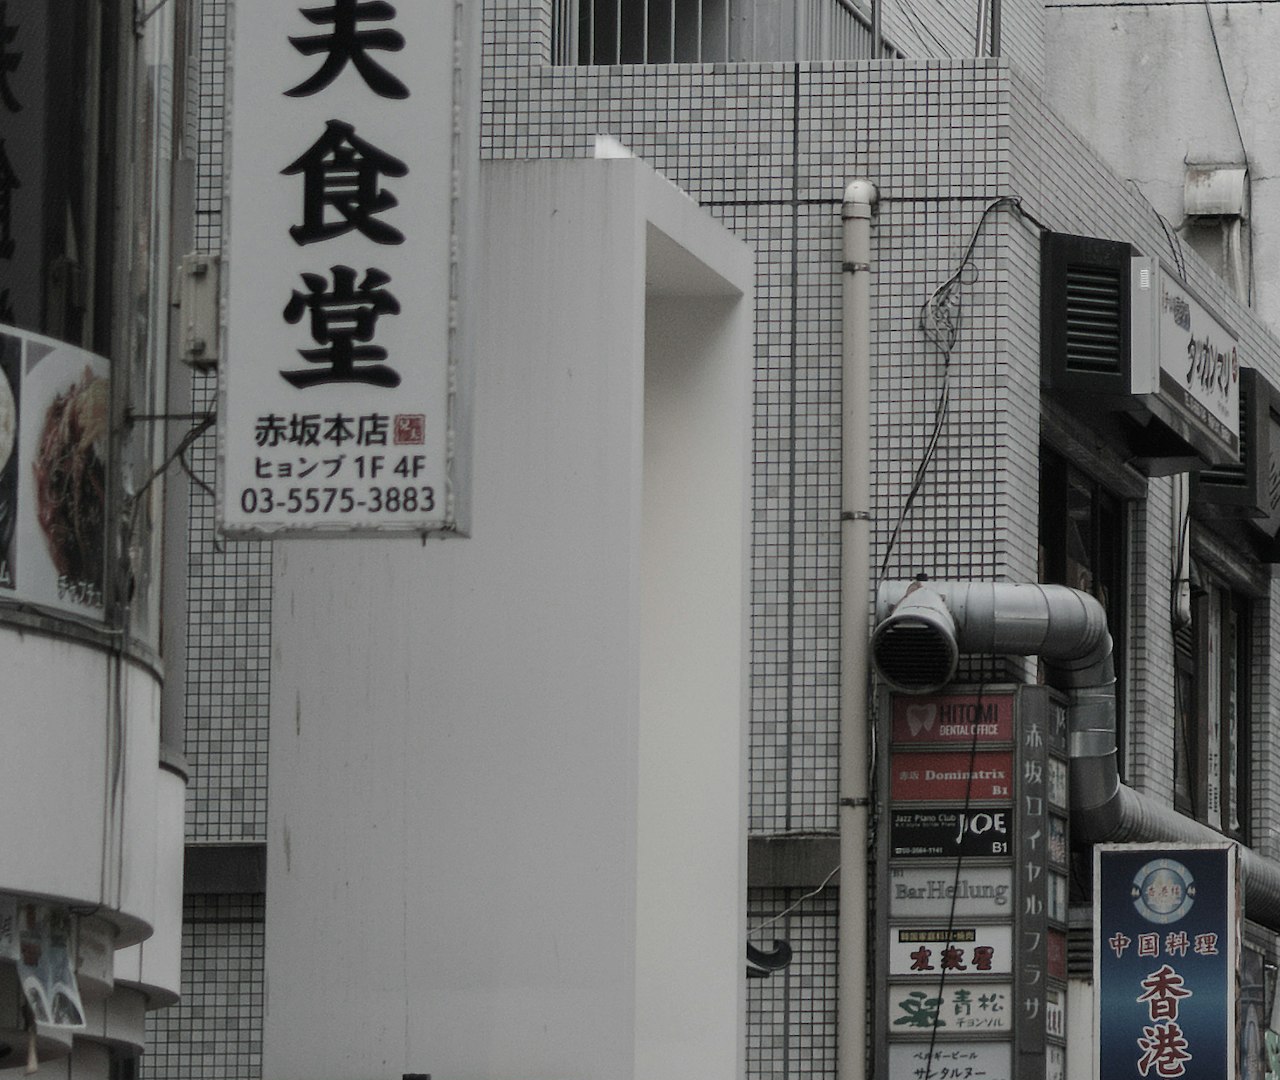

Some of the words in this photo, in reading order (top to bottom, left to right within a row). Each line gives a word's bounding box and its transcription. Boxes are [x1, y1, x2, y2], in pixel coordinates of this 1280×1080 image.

[255, 414, 388, 447] 赤坂本店
[255, 455, 348, 479] ヒョンブ
[354, 456, 384, 477] 1F
[393, 456, 425, 478] 4F
[241, 487, 434, 514] 03-5575-3883
[940, 703, 998, 723] HITOMI
[940, 724, 969, 736] DENTAL
[970, 723, 998, 735] OFFICE
[925, 769, 1005, 781] Dominatrix
[992, 785, 1008, 795] B1
[895, 813, 912, 823] Jazz
[914, 813, 936, 822] Piano
[938, 813, 957, 822] Club
[956, 812, 1006, 844] JOE
[992, 841, 1007, 853] B1
[1108, 931, 1219, 959] 中国料理
[952, 988, 1004, 1016] 青松
[956, 1017, 1004, 1028] チョンソル
[914, 1066, 986, 1080] サンタルヌー
